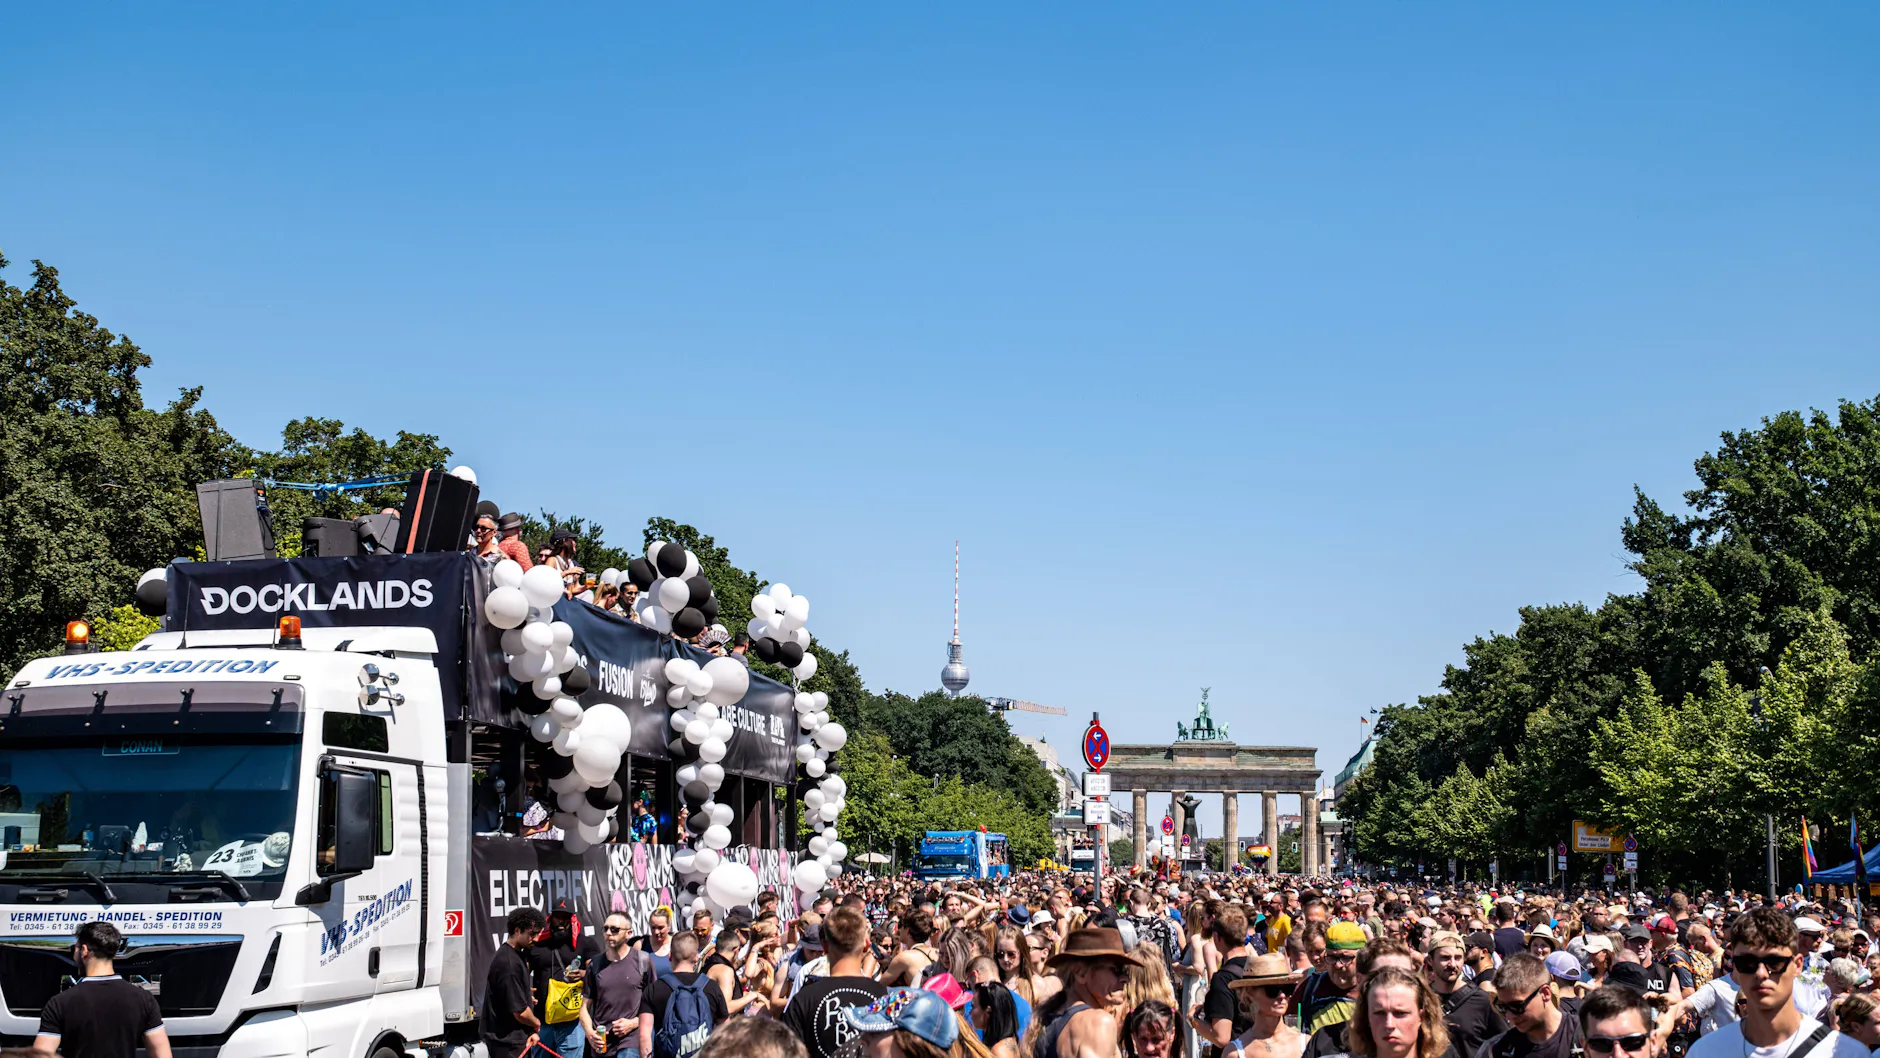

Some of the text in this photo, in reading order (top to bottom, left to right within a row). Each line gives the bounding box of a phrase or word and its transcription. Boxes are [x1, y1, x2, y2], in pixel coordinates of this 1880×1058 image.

[200, 578, 434, 616] DOCKLANDS
[45, 659, 280, 680] VHS-SPEDITION
[598, 660, 634, 700] FUSION
[737, 706, 766, 736] CULTURE
[120, 740, 163, 753] CONAN
[208, 848, 235, 865] 23
[489, 869, 594, 917] ELECTRIFY
[10, 912, 88, 922] VERMIETUNG
[97, 912, 146, 921] HANDEL
[156, 911, 222, 921] SPEDITION
[142, 922, 164, 930] 0345
[172, 922, 182, 930] 61
[185, 922, 195, 930] 38
[320, 878, 413, 956] VHS-SPEDITION
[680, 1021, 710, 1057] NIKE
